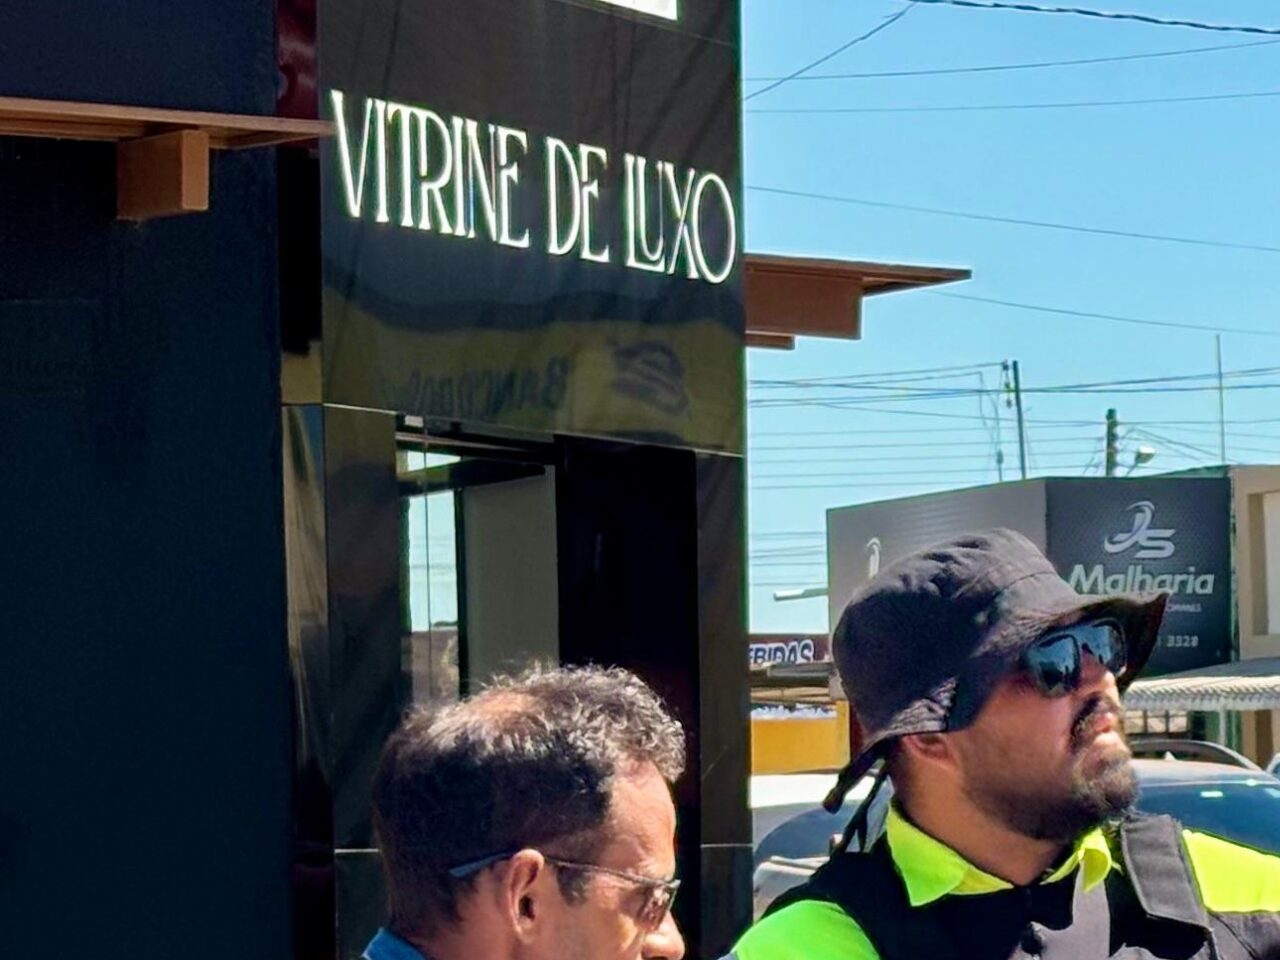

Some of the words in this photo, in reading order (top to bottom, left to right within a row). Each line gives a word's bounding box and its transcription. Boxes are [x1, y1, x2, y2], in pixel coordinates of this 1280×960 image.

[331, 88, 529, 249] VITRINE
[545, 136, 609, 263] DE
[624, 153, 736, 284] LUXO
[1069, 563, 1215, 595] Malharia
